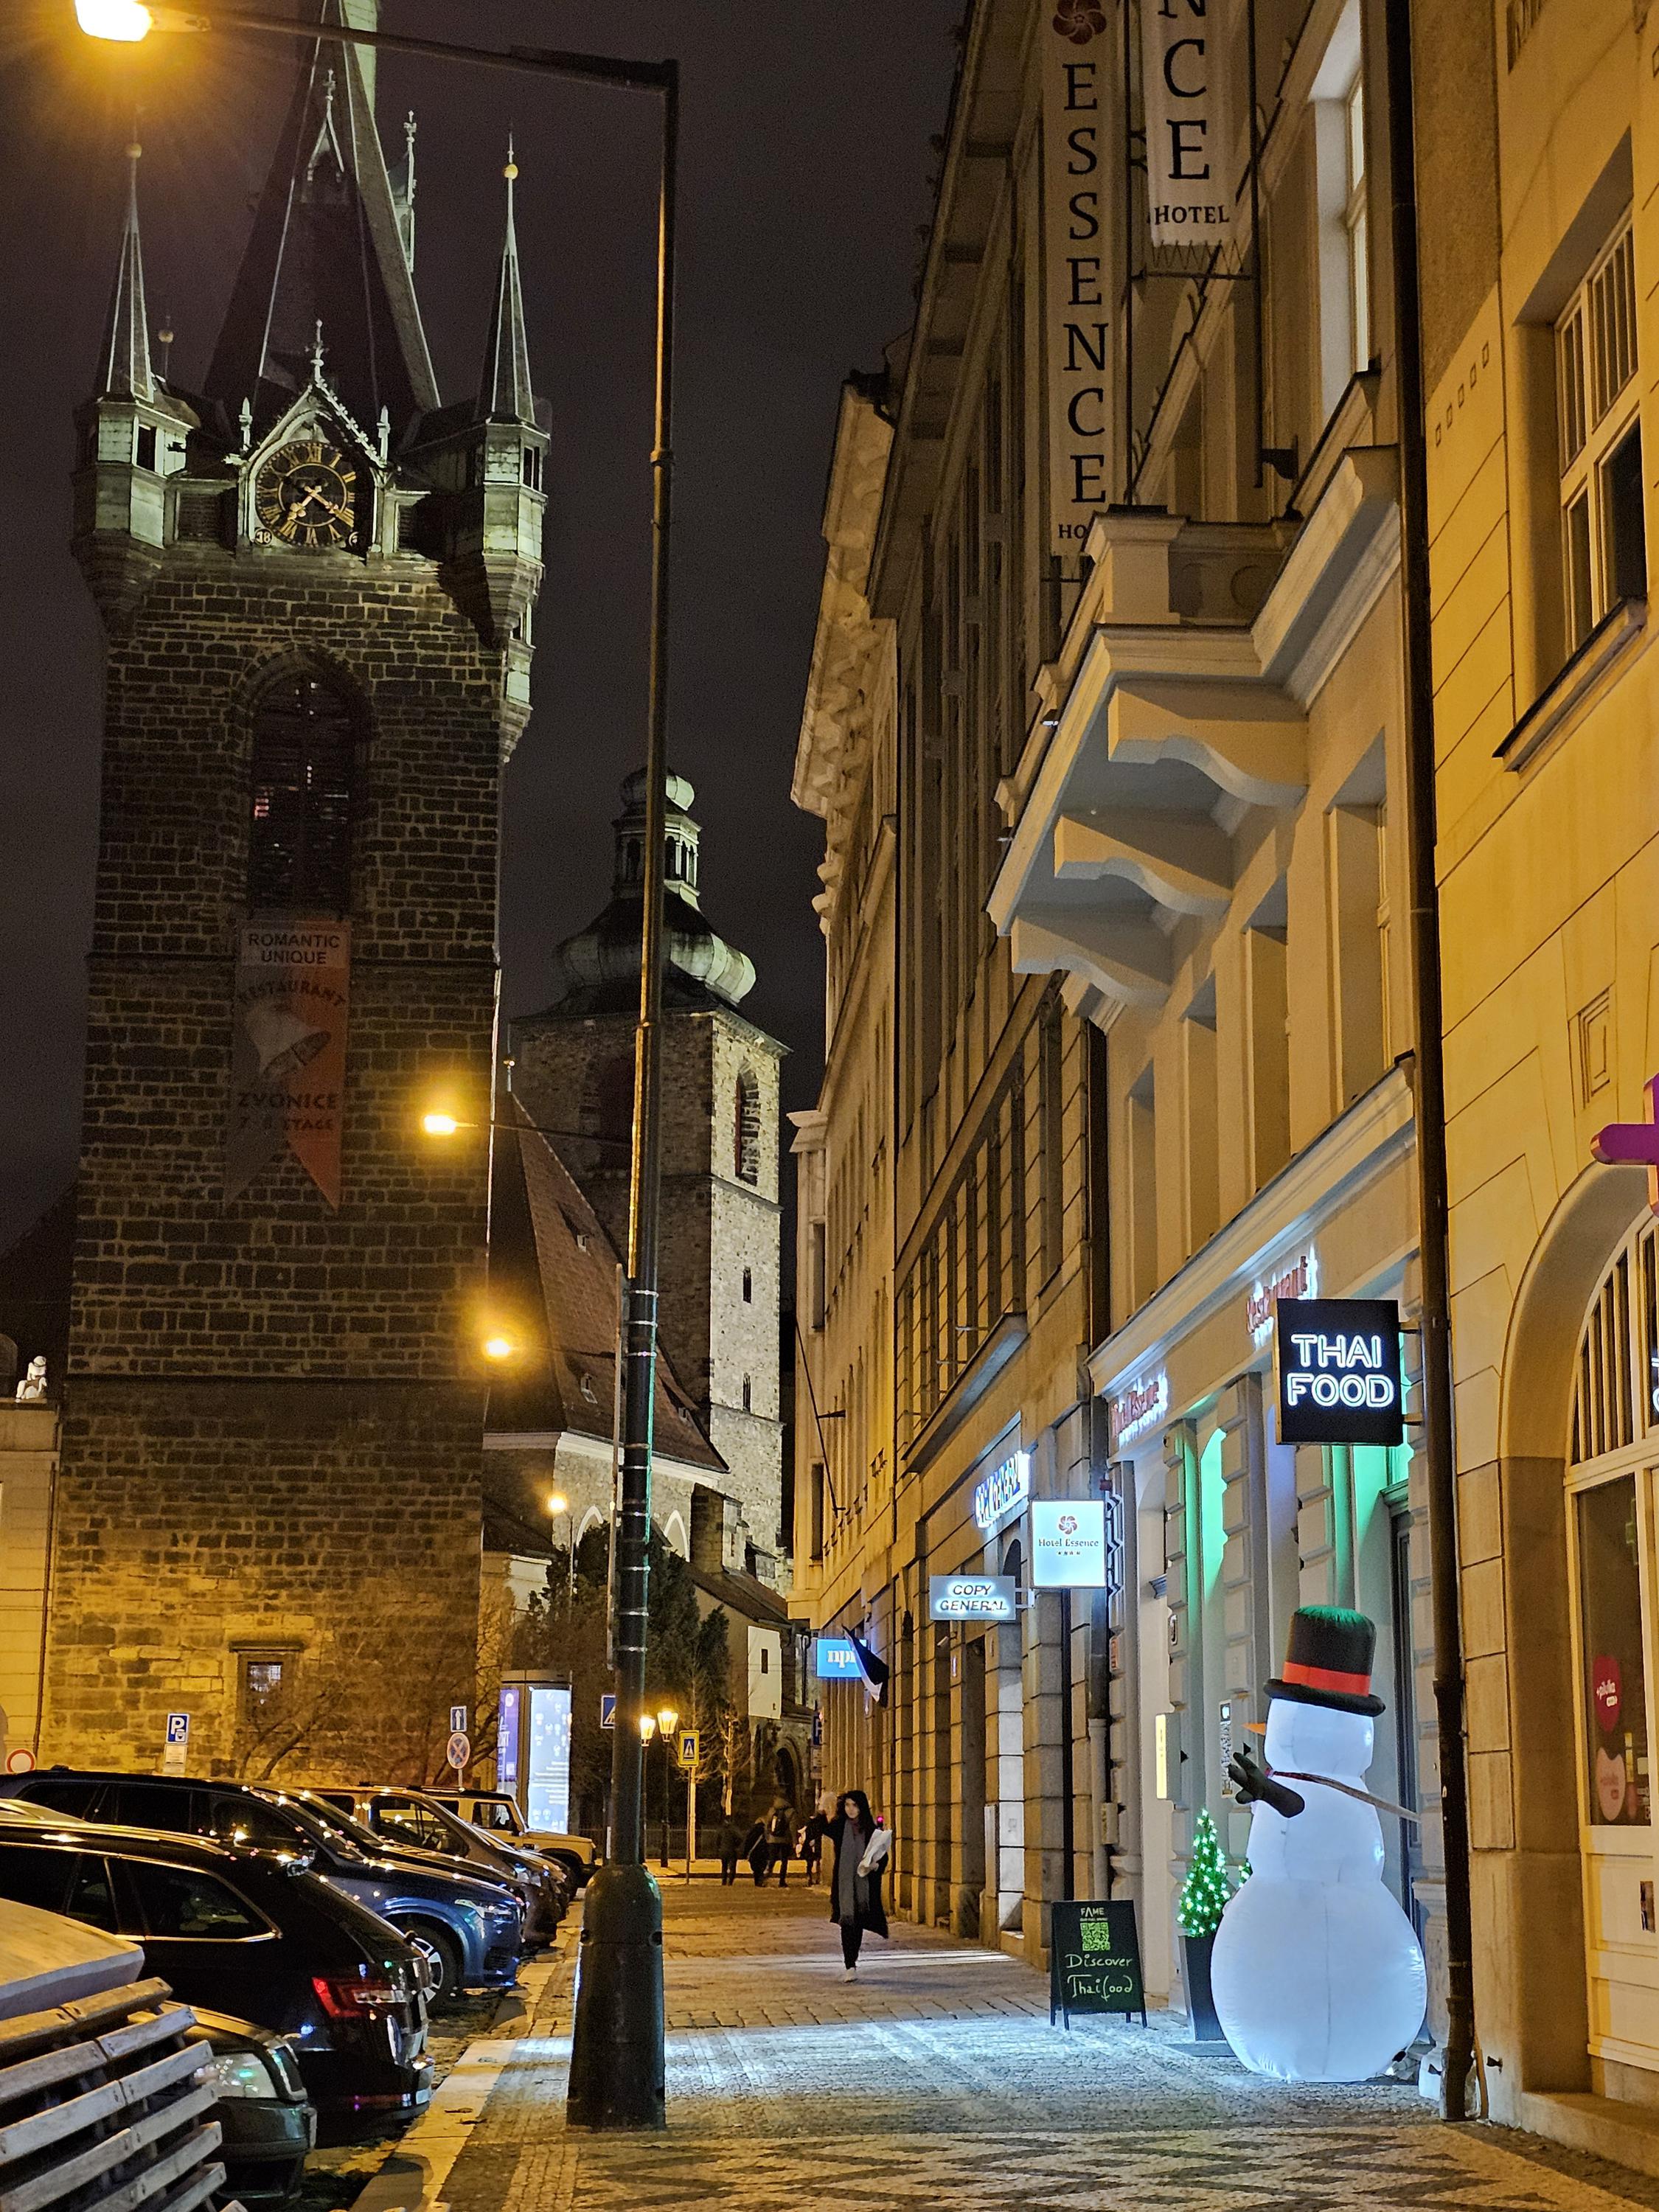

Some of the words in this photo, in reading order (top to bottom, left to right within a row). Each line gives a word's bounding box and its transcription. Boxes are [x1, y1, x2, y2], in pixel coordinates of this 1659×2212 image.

[1153, 205, 1230, 225] HOTEL
[1062, 62, 1109, 504] ESSENCE
[248, 933, 340, 949] ROMANTIC
[260, 950, 327, 965] UNIQUE
[1290, 1333, 1382, 1368] THAI
[1286, 1373, 1394, 1408] FOOD
[1038, 1537, 1062, 1547] Hotel
[1065, 1538, 1099, 1547] Essence
[953, 1585, 992, 1596] COPY
[940, 1600, 1007, 1612] GENERAL
[170, 1717, 185, 1735] P
[1080, 1907, 1105, 1917] FAME
[1065, 1953, 1133, 1969] Discover
